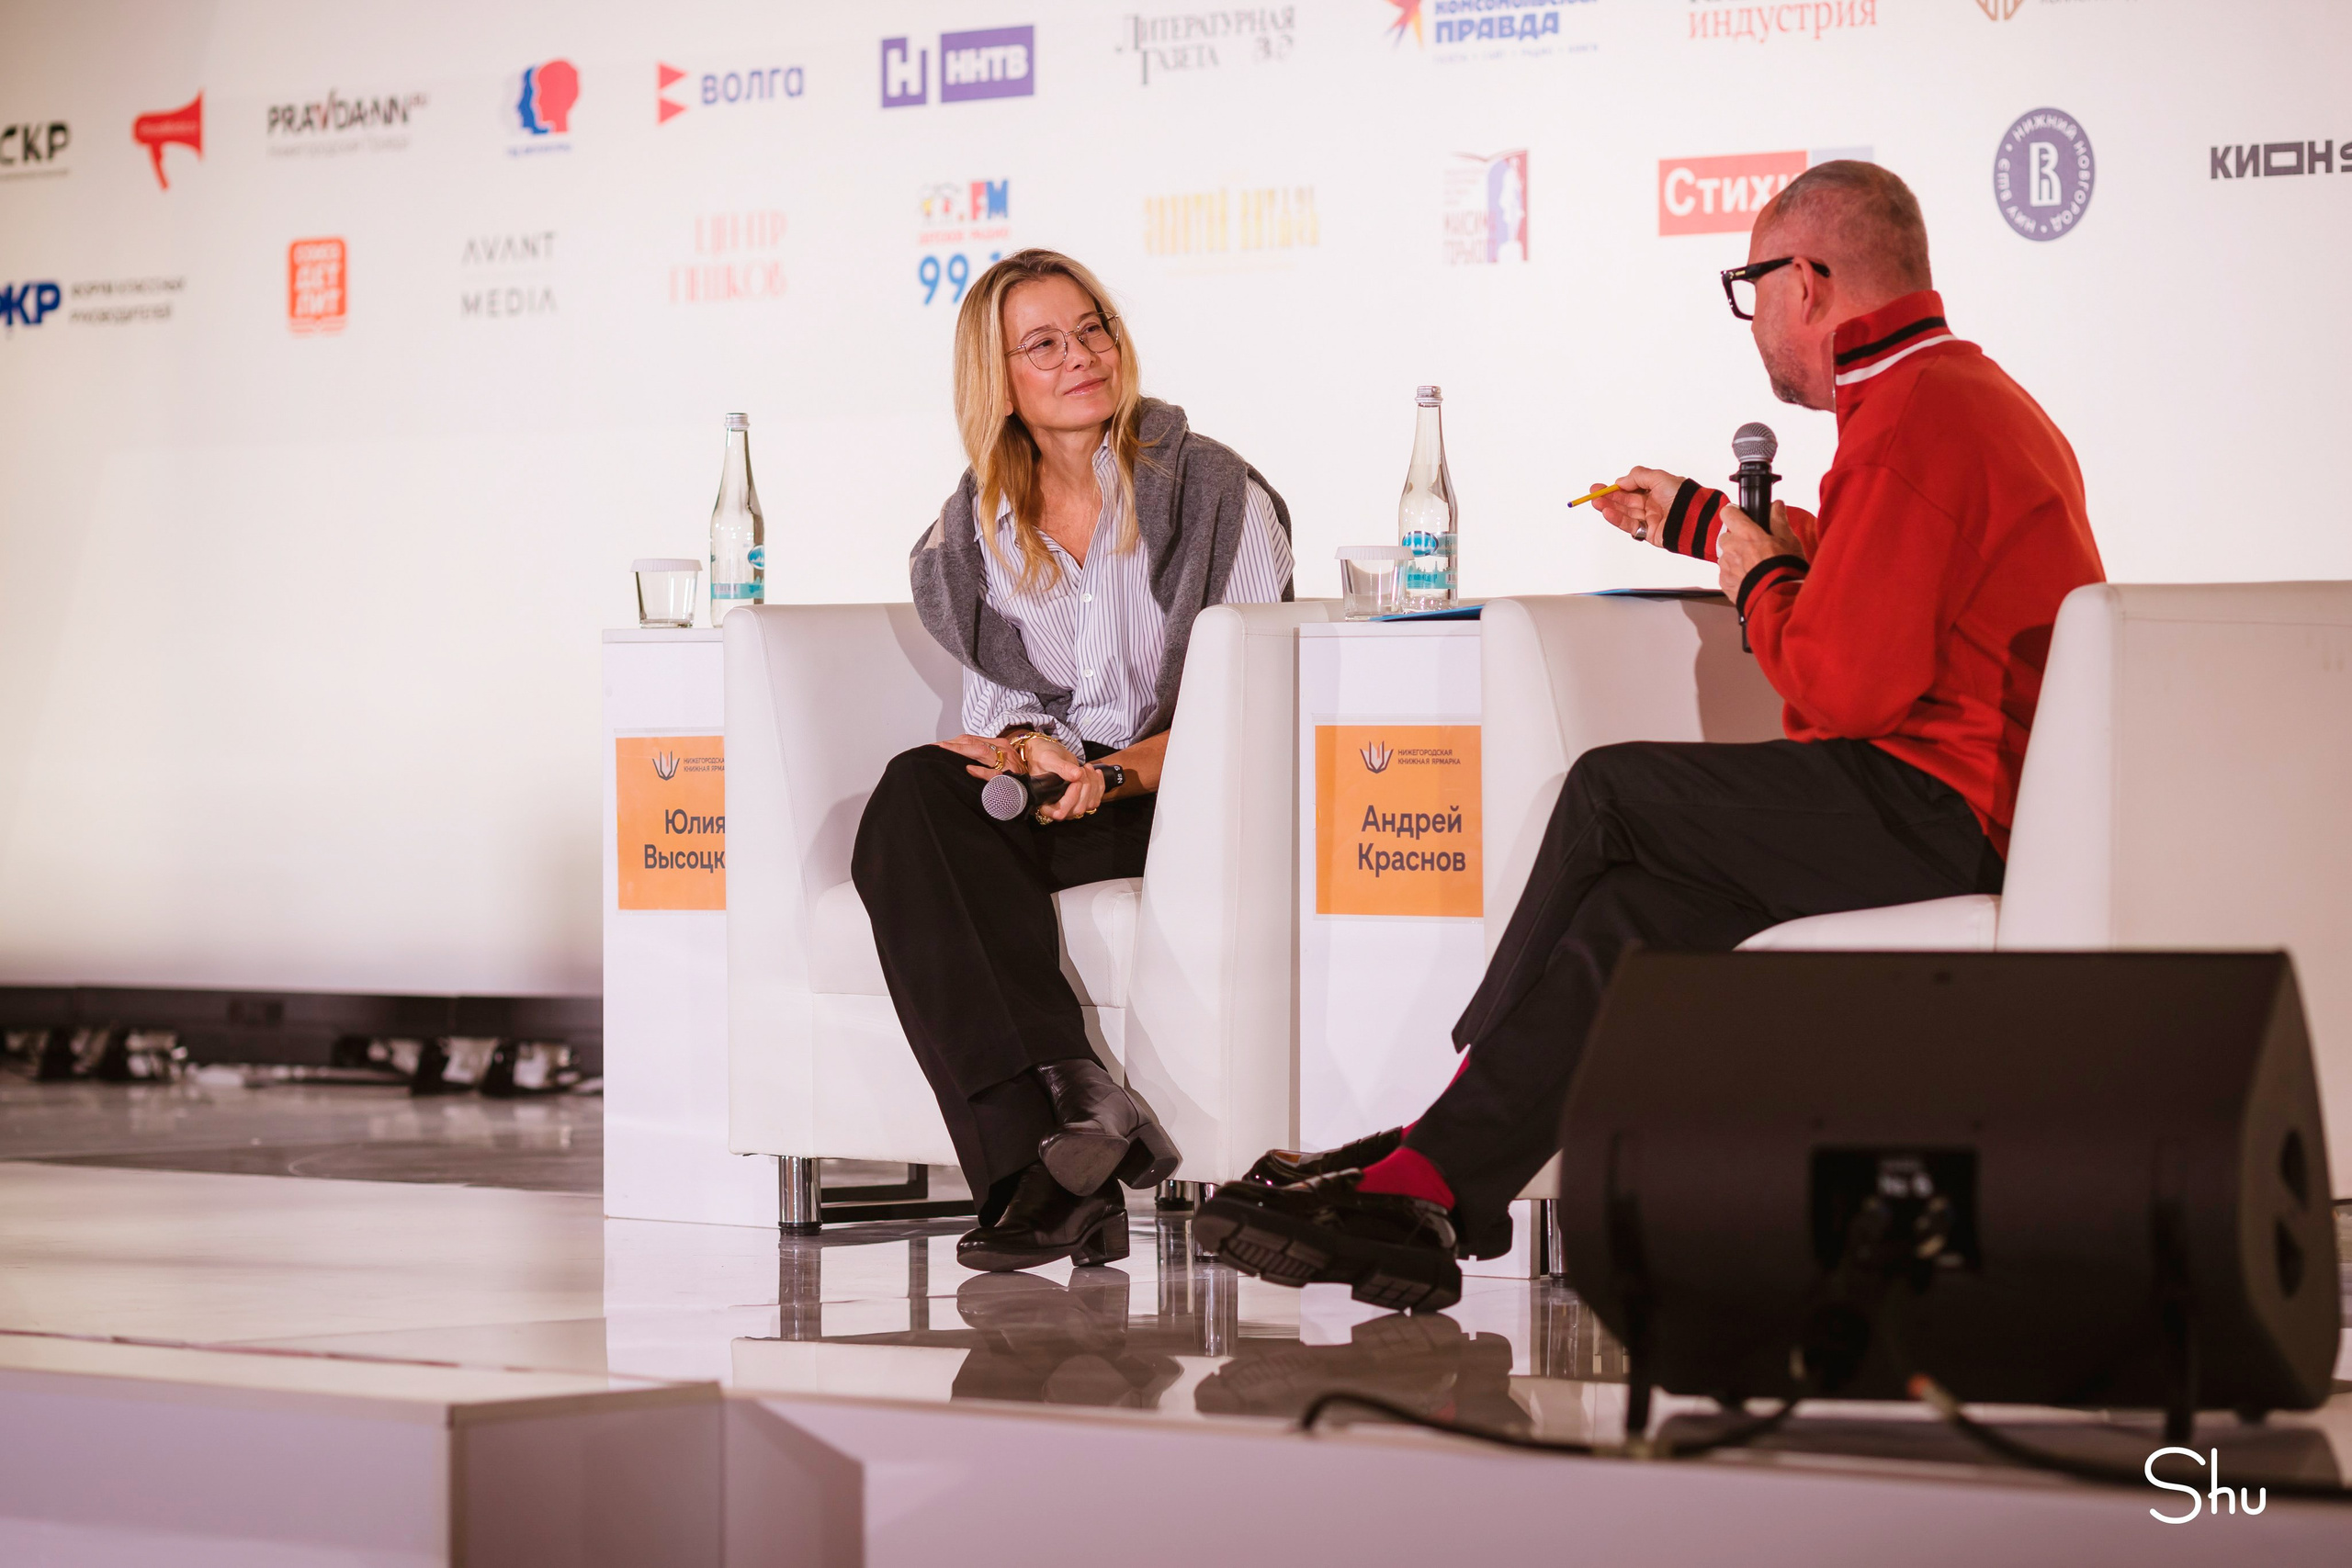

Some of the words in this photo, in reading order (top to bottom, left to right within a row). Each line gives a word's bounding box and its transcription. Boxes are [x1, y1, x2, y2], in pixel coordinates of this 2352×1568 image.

[1435, 11, 1560, 43] ПРАВДА
[1688, 0, 1877, 43] индустрия
[945, 44, 1029, 85] ННТВ
[2012, 114, 2077, 142] НИЖНИЙ
[2211, 140, 2334, 180] КИОН
[2050, 140, 2091, 232] НОВГОРОД
[461, 231, 558, 266] AVANT
[461, 286, 560, 319] MEDIA
[665, 808, 725, 834] Юлия
[1362, 805, 1463, 840] Андрей
[644, 844, 725, 874] Высоцк
[1358, 842, 1466, 877] Краснов
